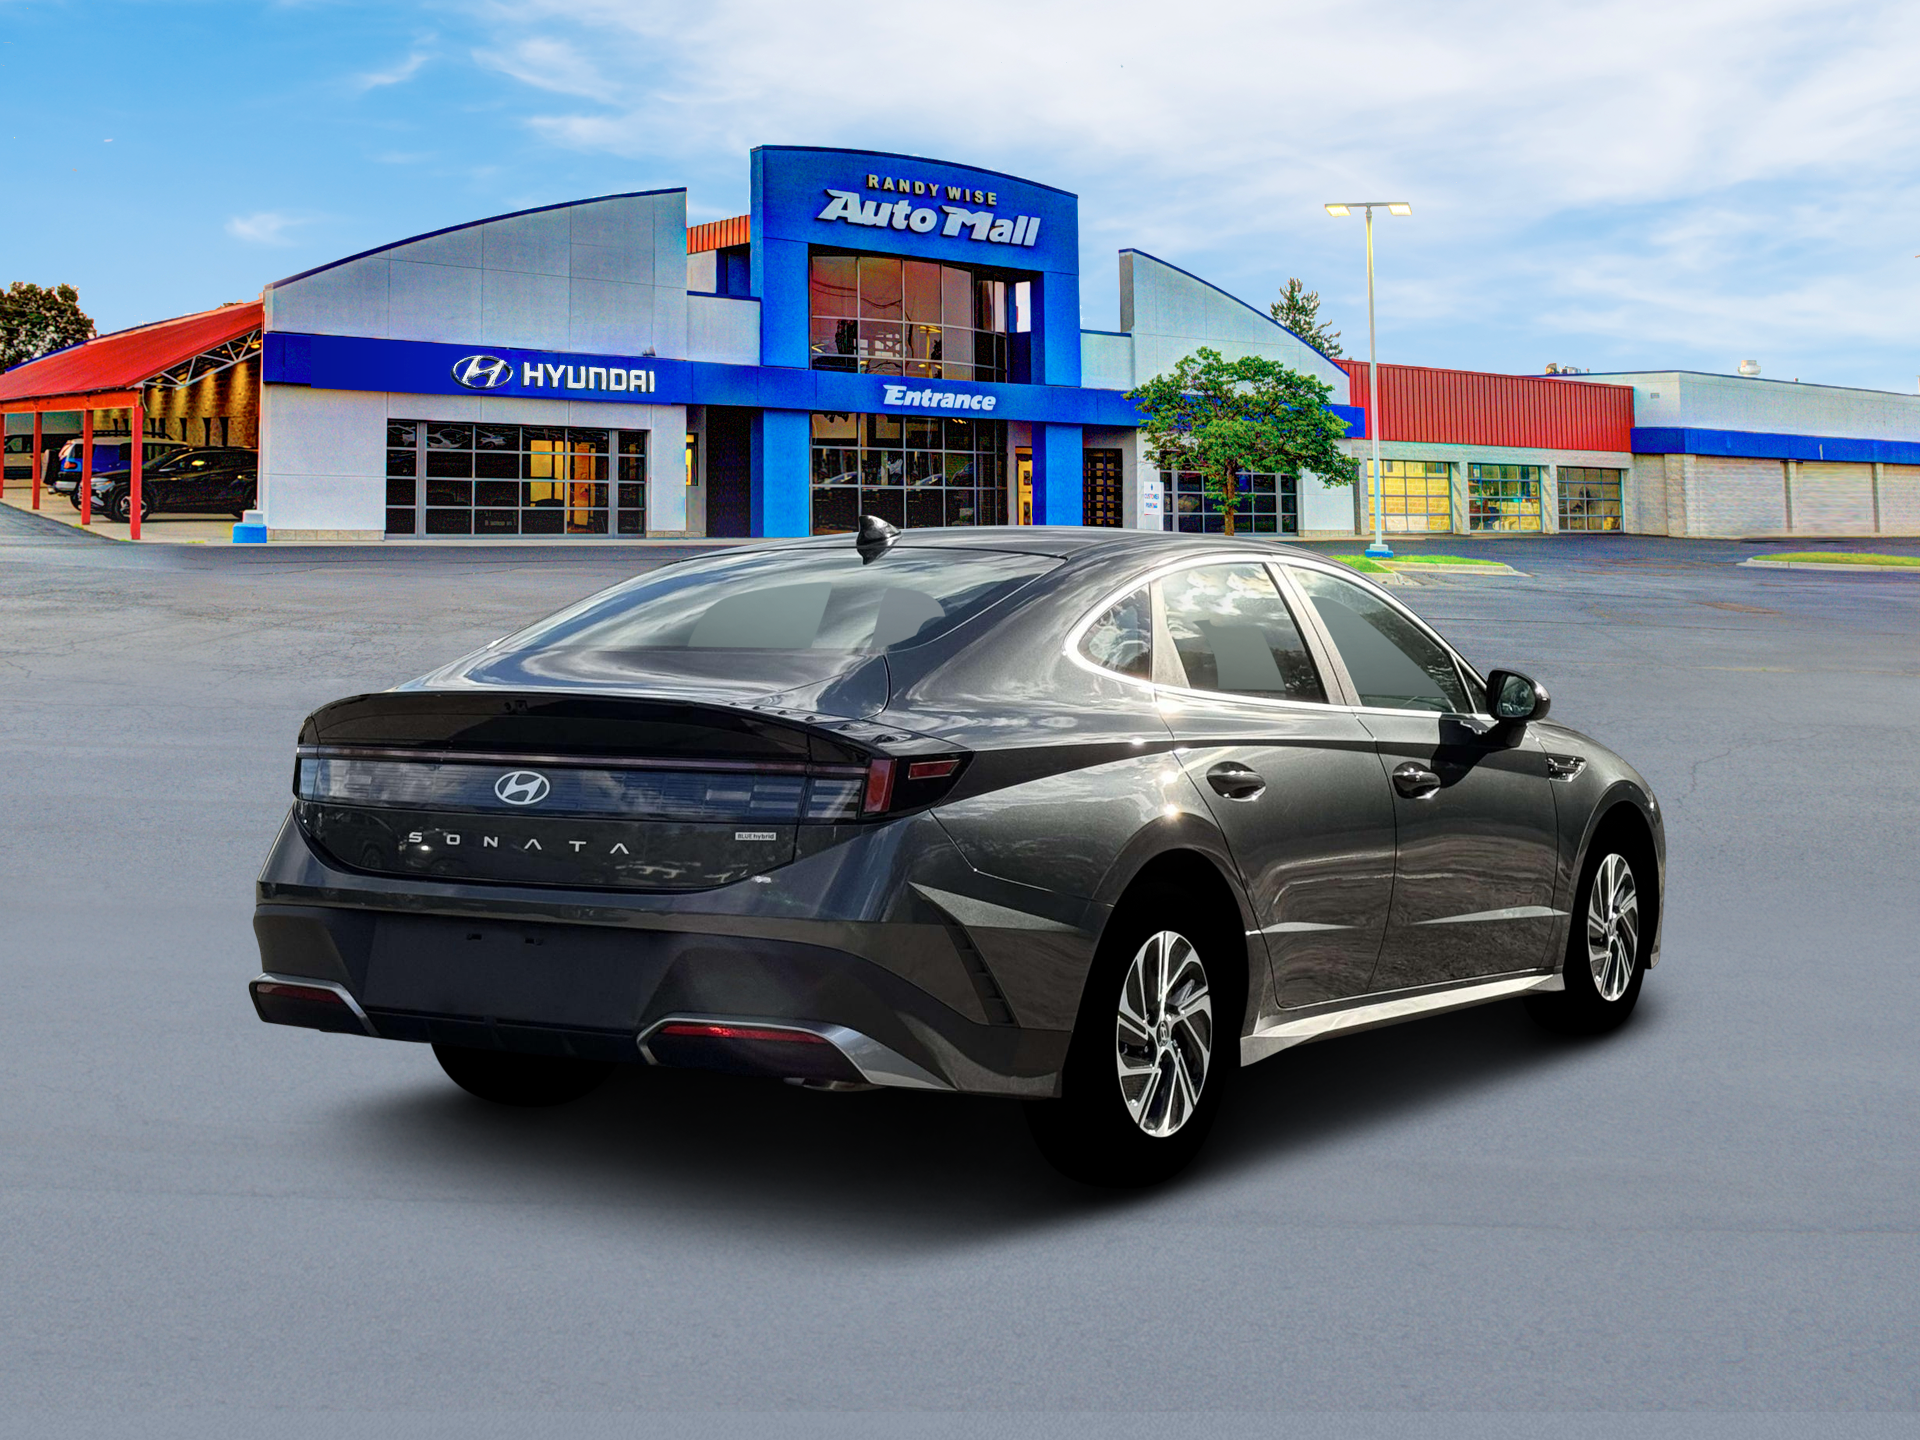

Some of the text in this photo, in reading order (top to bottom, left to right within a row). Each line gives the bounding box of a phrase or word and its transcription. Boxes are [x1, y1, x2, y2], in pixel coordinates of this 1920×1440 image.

[867, 174, 998, 205] RANDY WISE
[817, 189, 1041, 247] Auto Mall
[522, 362, 656, 394] HYUNDAI
[883, 384, 996, 411] Entrance
[408, 831, 630, 855] SONATA
